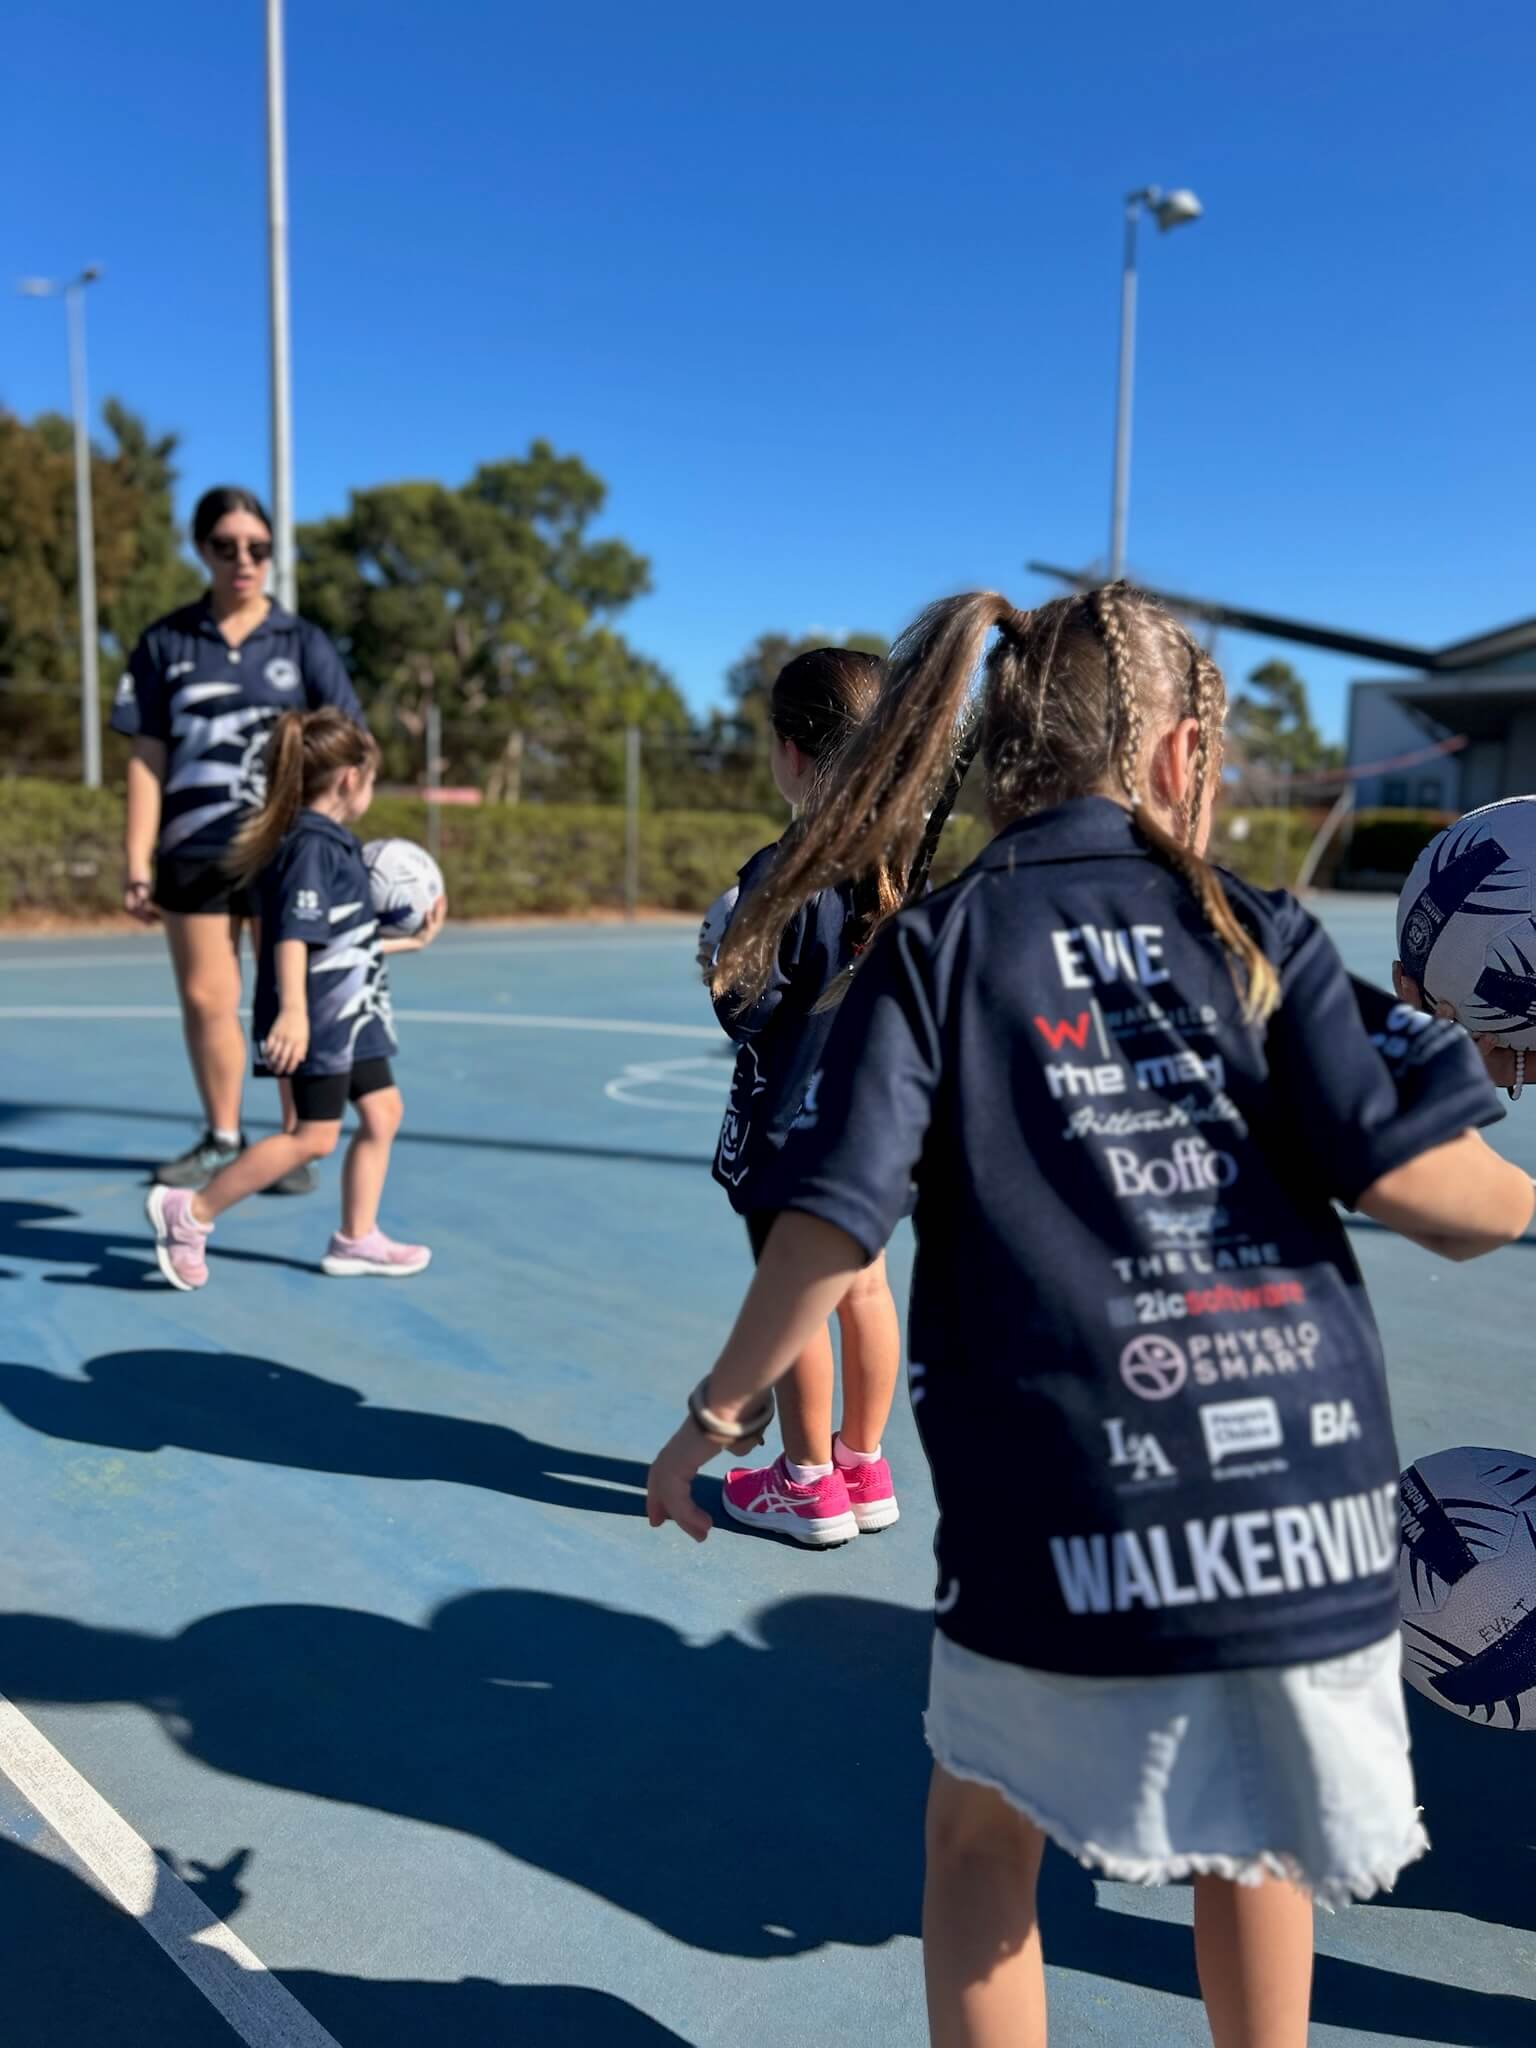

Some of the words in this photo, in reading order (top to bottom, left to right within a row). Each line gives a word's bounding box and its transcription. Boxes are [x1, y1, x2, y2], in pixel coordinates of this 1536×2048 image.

[1051, 924, 1170, 989] EVIE
[1105, 1137, 1238, 1198] Boffo
[1187, 1321, 1321, 1358] PHYSIO
[1192, 1347, 1317, 1385] SMART
